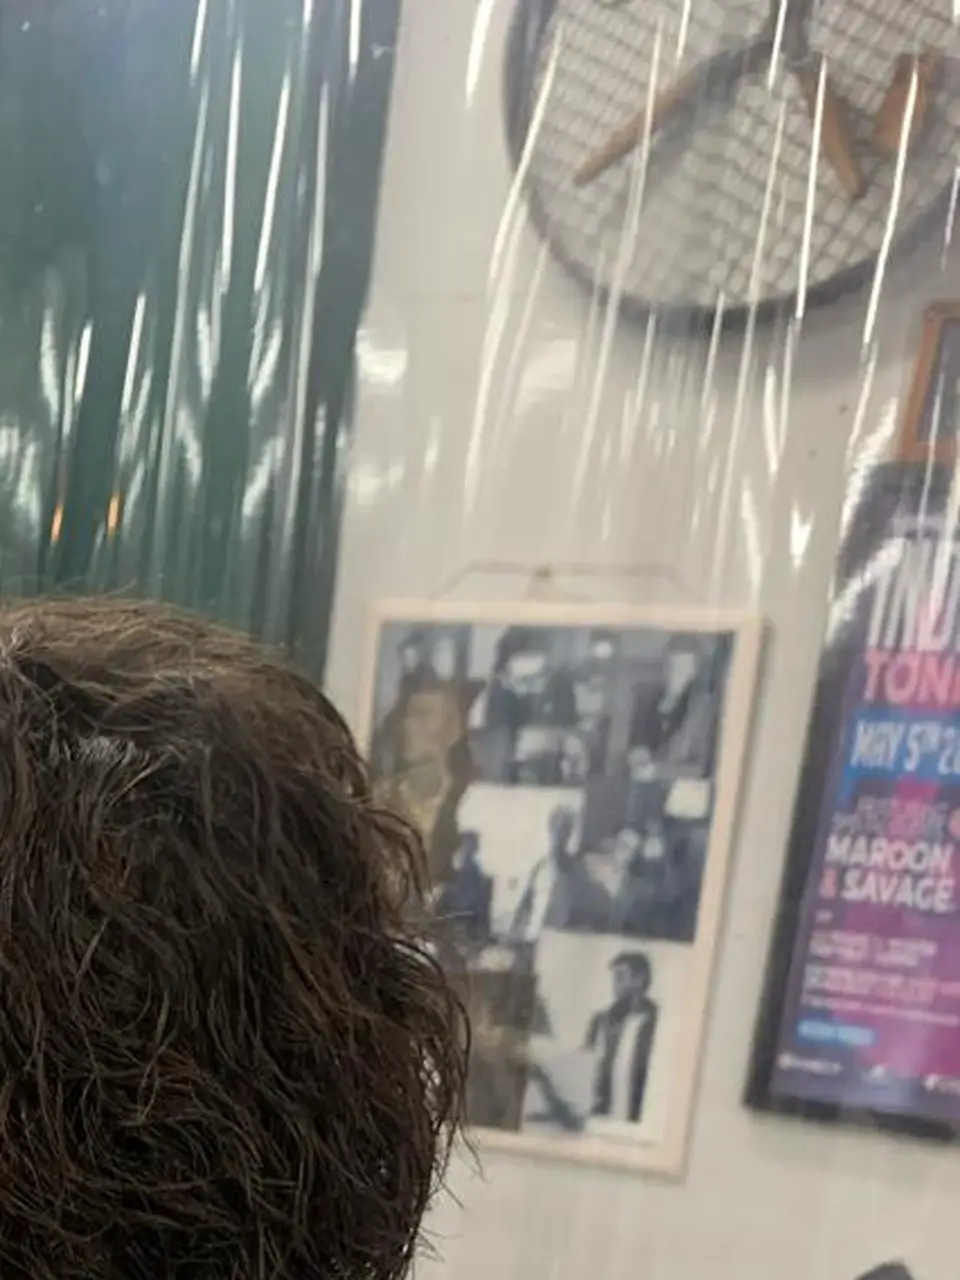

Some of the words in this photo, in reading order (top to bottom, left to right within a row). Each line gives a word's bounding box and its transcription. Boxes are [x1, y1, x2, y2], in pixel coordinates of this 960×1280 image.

[850, 720, 906, 770] MAY
[825, 836, 954, 873] MAROON
[841, 867, 957, 914] SAVAGE
